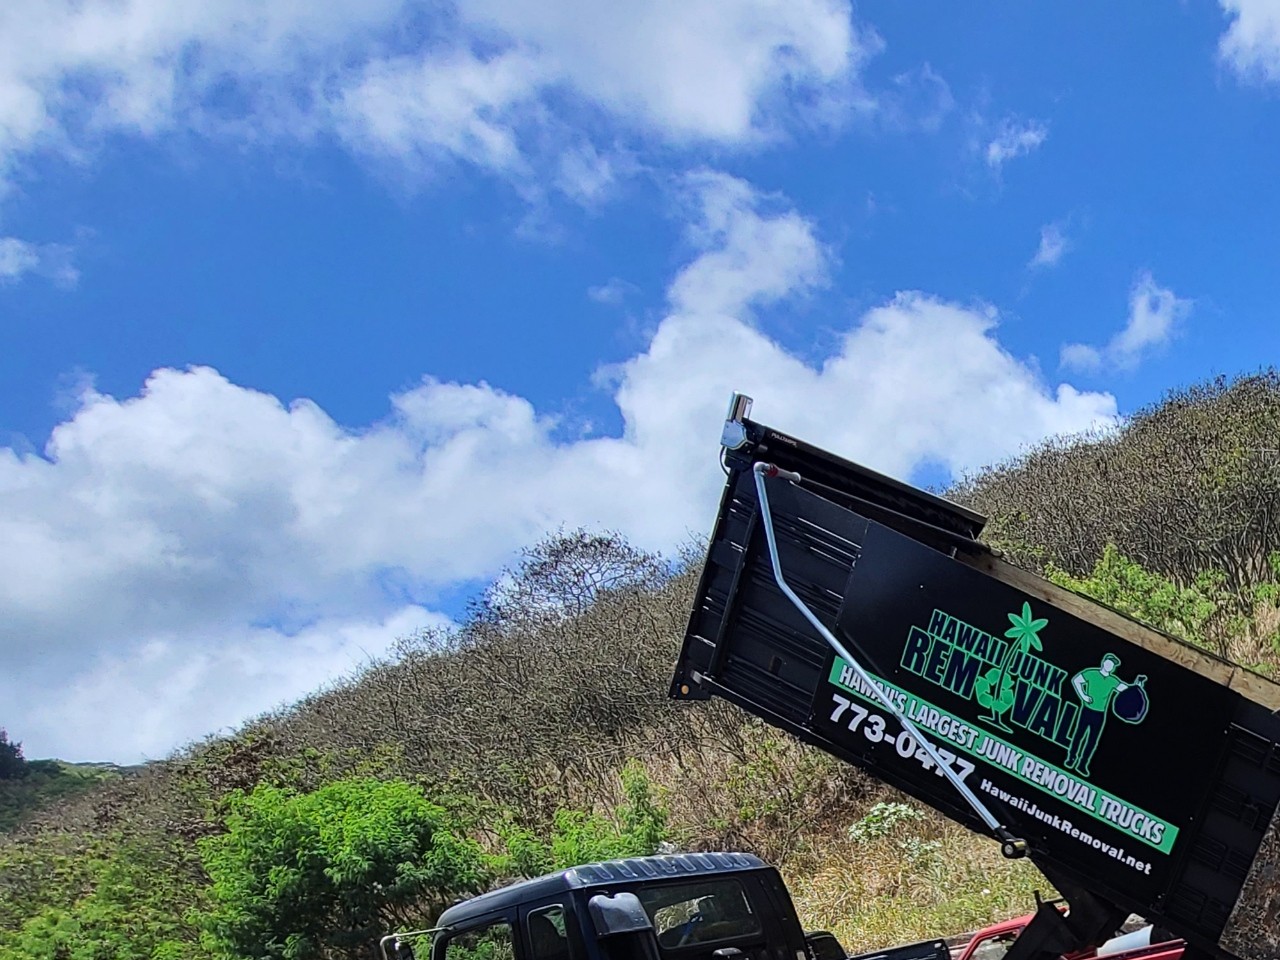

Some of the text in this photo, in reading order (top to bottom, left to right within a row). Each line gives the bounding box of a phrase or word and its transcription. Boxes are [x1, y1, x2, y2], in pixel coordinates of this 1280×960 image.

[928, 608, 1068, 699] HAWAII JUNK
[907, 700, 979, 749] LARGEST
[976, 736, 1022, 772] JUNK
[1021, 756, 1098, 812] REMOVAL
[1099, 795, 1166, 844] TRUCKS
[980, 779, 1152, 875] HawaiiJunkRemoval.net
